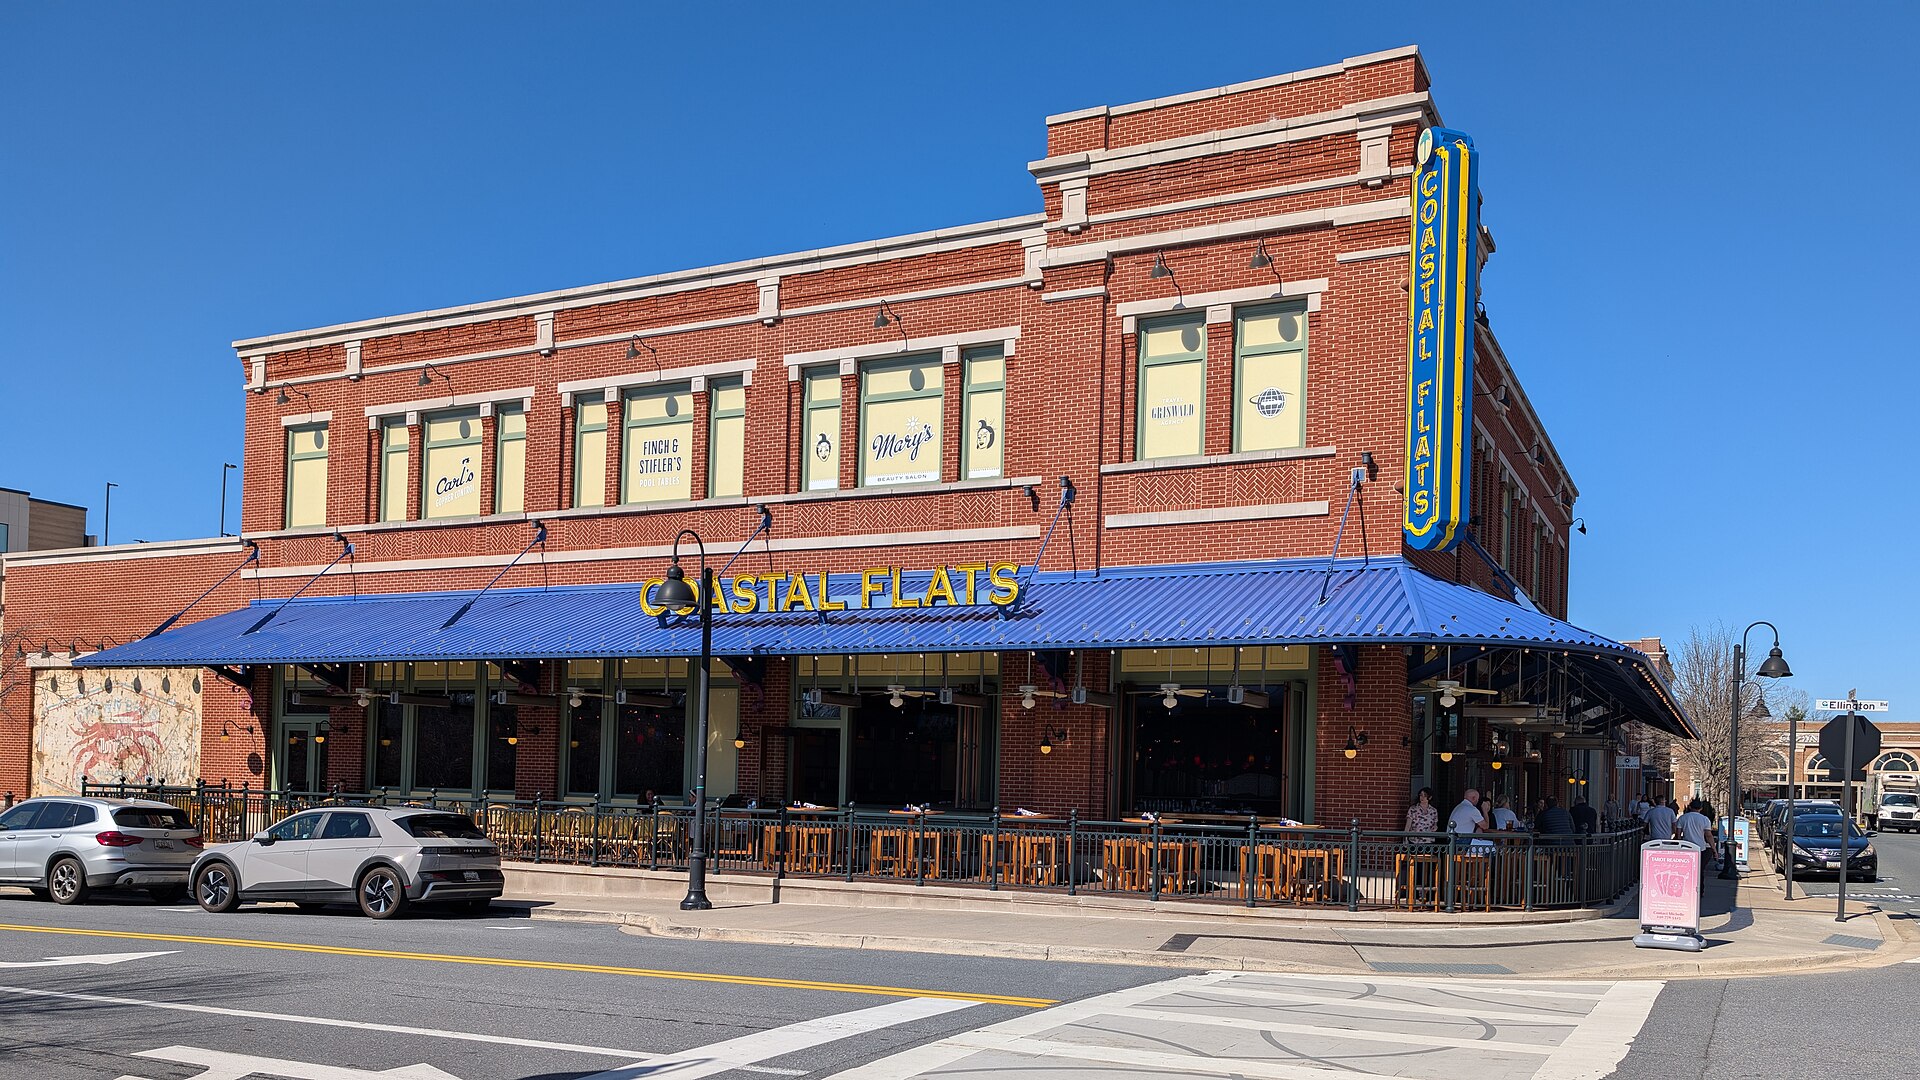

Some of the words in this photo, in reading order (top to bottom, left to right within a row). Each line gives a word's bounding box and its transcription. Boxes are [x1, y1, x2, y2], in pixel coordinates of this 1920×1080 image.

[1417, 169, 1438, 363] COASTAL
[643, 439, 670, 456] FINCH
[672, 438, 679, 453] &
[872, 423, 935, 461] Mary's
[1413, 380, 1432, 517] FLATS
[436, 464, 475, 496] Carl's
[639, 456, 682, 474] STIFLER'S
[639, 478, 656, 488] POOL
[657, 475, 680, 487] TABLES
[861, 560, 1022, 611] FLATS
[1829, 701, 1876, 712] Ellington
